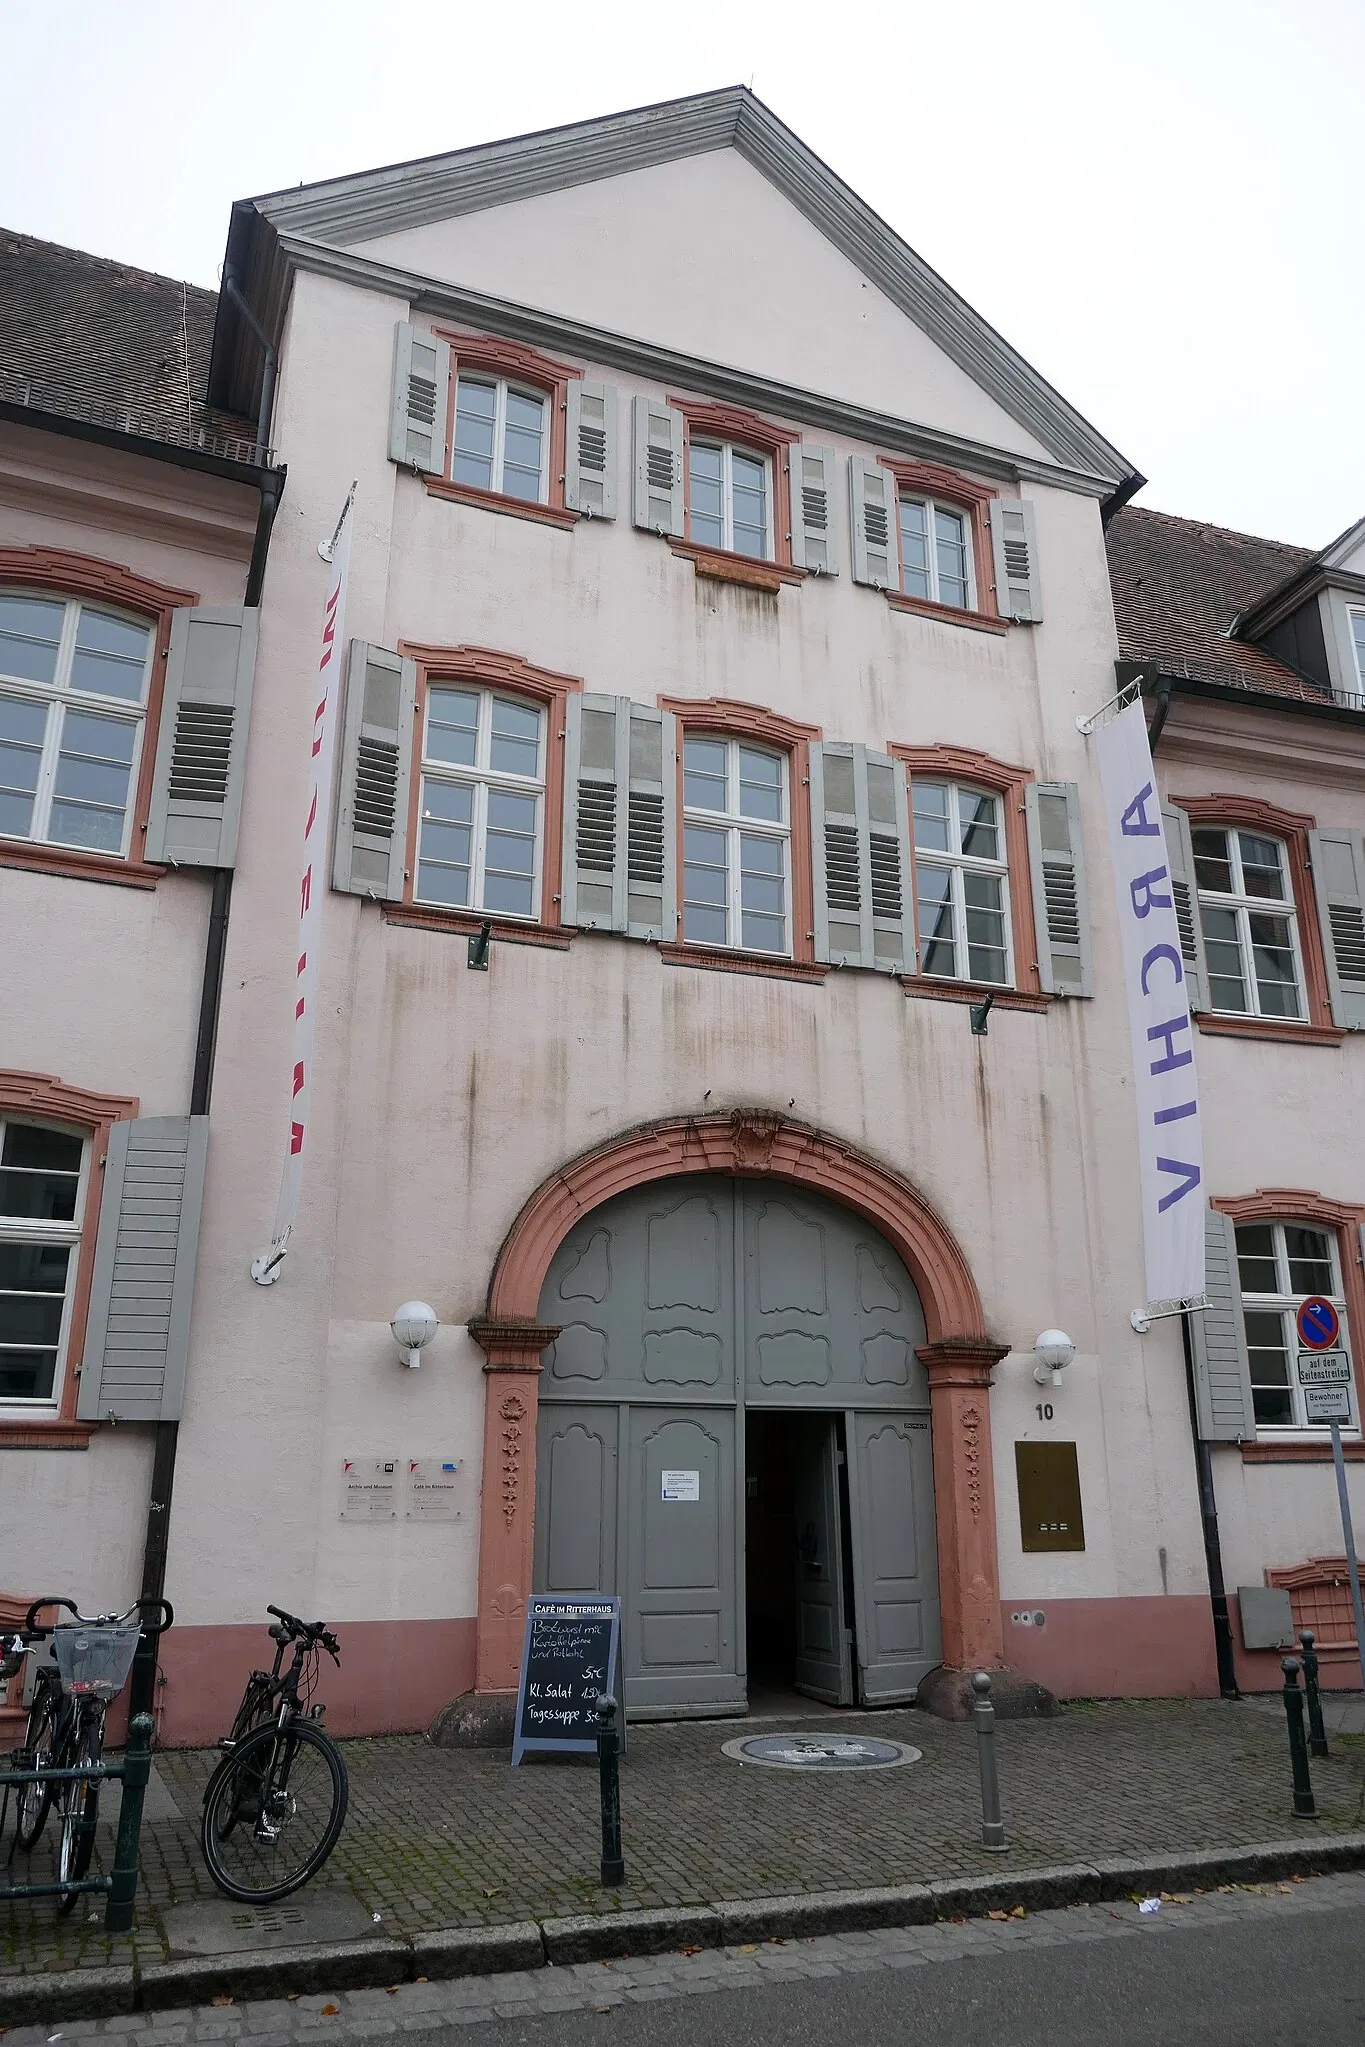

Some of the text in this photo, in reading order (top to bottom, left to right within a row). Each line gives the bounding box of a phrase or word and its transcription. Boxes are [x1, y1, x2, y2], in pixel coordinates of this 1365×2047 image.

[1121, 783, 1201, 1213] ARCHIV
[1309, 1357, 1337, 1368] auf dem
[1300, 1367, 1349, 1380] Seitenstreifen
[1309, 1392, 1343, 1401] Bewohner
[1036, 1403, 1053, 1420] 10
[566, 1605, 612, 1613] RITTERHAUS
[531, 1649, 551, 1659] und
[529, 1683, 543, 1698] Kl.
[545, 1683, 572, 1699] Salat
[527, 1703, 580, 1725] Tagessuppe
